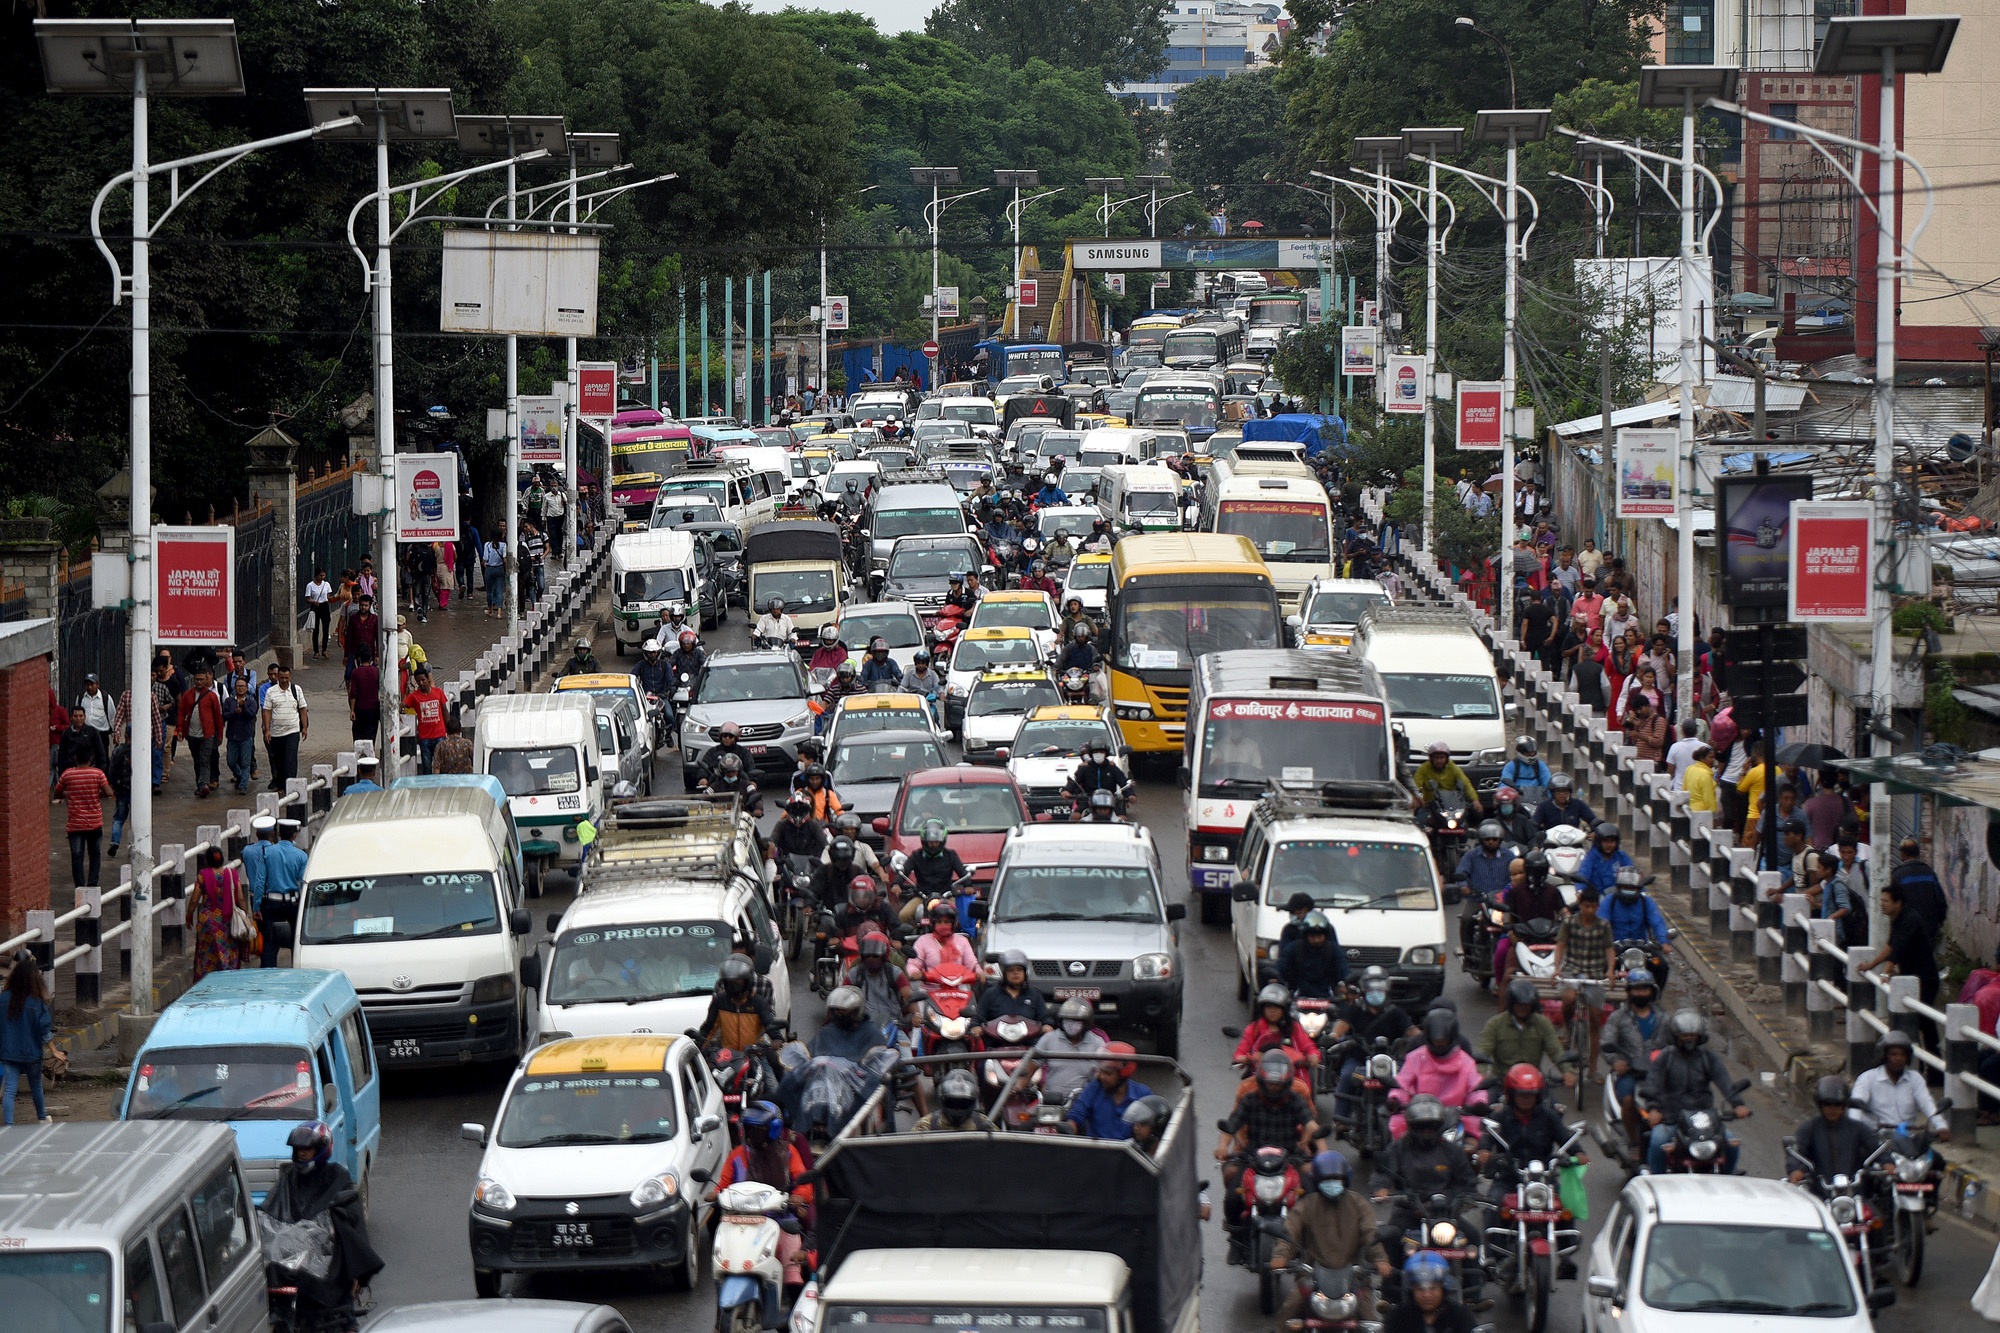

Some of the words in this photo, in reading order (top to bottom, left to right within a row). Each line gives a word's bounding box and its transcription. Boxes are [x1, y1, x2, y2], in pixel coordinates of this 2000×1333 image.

[1088, 248, 1149, 259] SAMSUNG
[1008, 352, 1029, 360] WHITE
[1040, 351, 1060, 359] TIGER
[655, 441, 688, 449] यातायात
[1805, 547, 1845, 557] JAPAN
[1806, 556, 1828, 564] NO.1
[1831, 556, 1859, 564] PAINT
[168, 569, 205, 580] JAPAN
[207, 567, 221, 580] को
[168, 579, 190, 587] NO.1
[192, 579, 220, 587] PAINT
[168, 587, 182, 597] अब
[184, 586, 217, 597] नेपालमा
[1796, 607, 1815, 615] SAVE
[1817, 607, 1867, 615] ELECTRICITY
[159, 629, 179, 637] SAVE
[1445, 675, 1487, 684] EXPRESS
[1234, 701, 1285, 719] कान्तिपुर
[1301, 705, 1354, 719] यातायात
[1030, 867, 1124, 878] NISSAN
[339, 879, 377, 892] TOY
[423, 874, 461, 886] OTA
[578, 934, 595, 942] KIA
[603, 926, 684, 941] PREGIO
[543, 1079, 561, 1090] श्री
